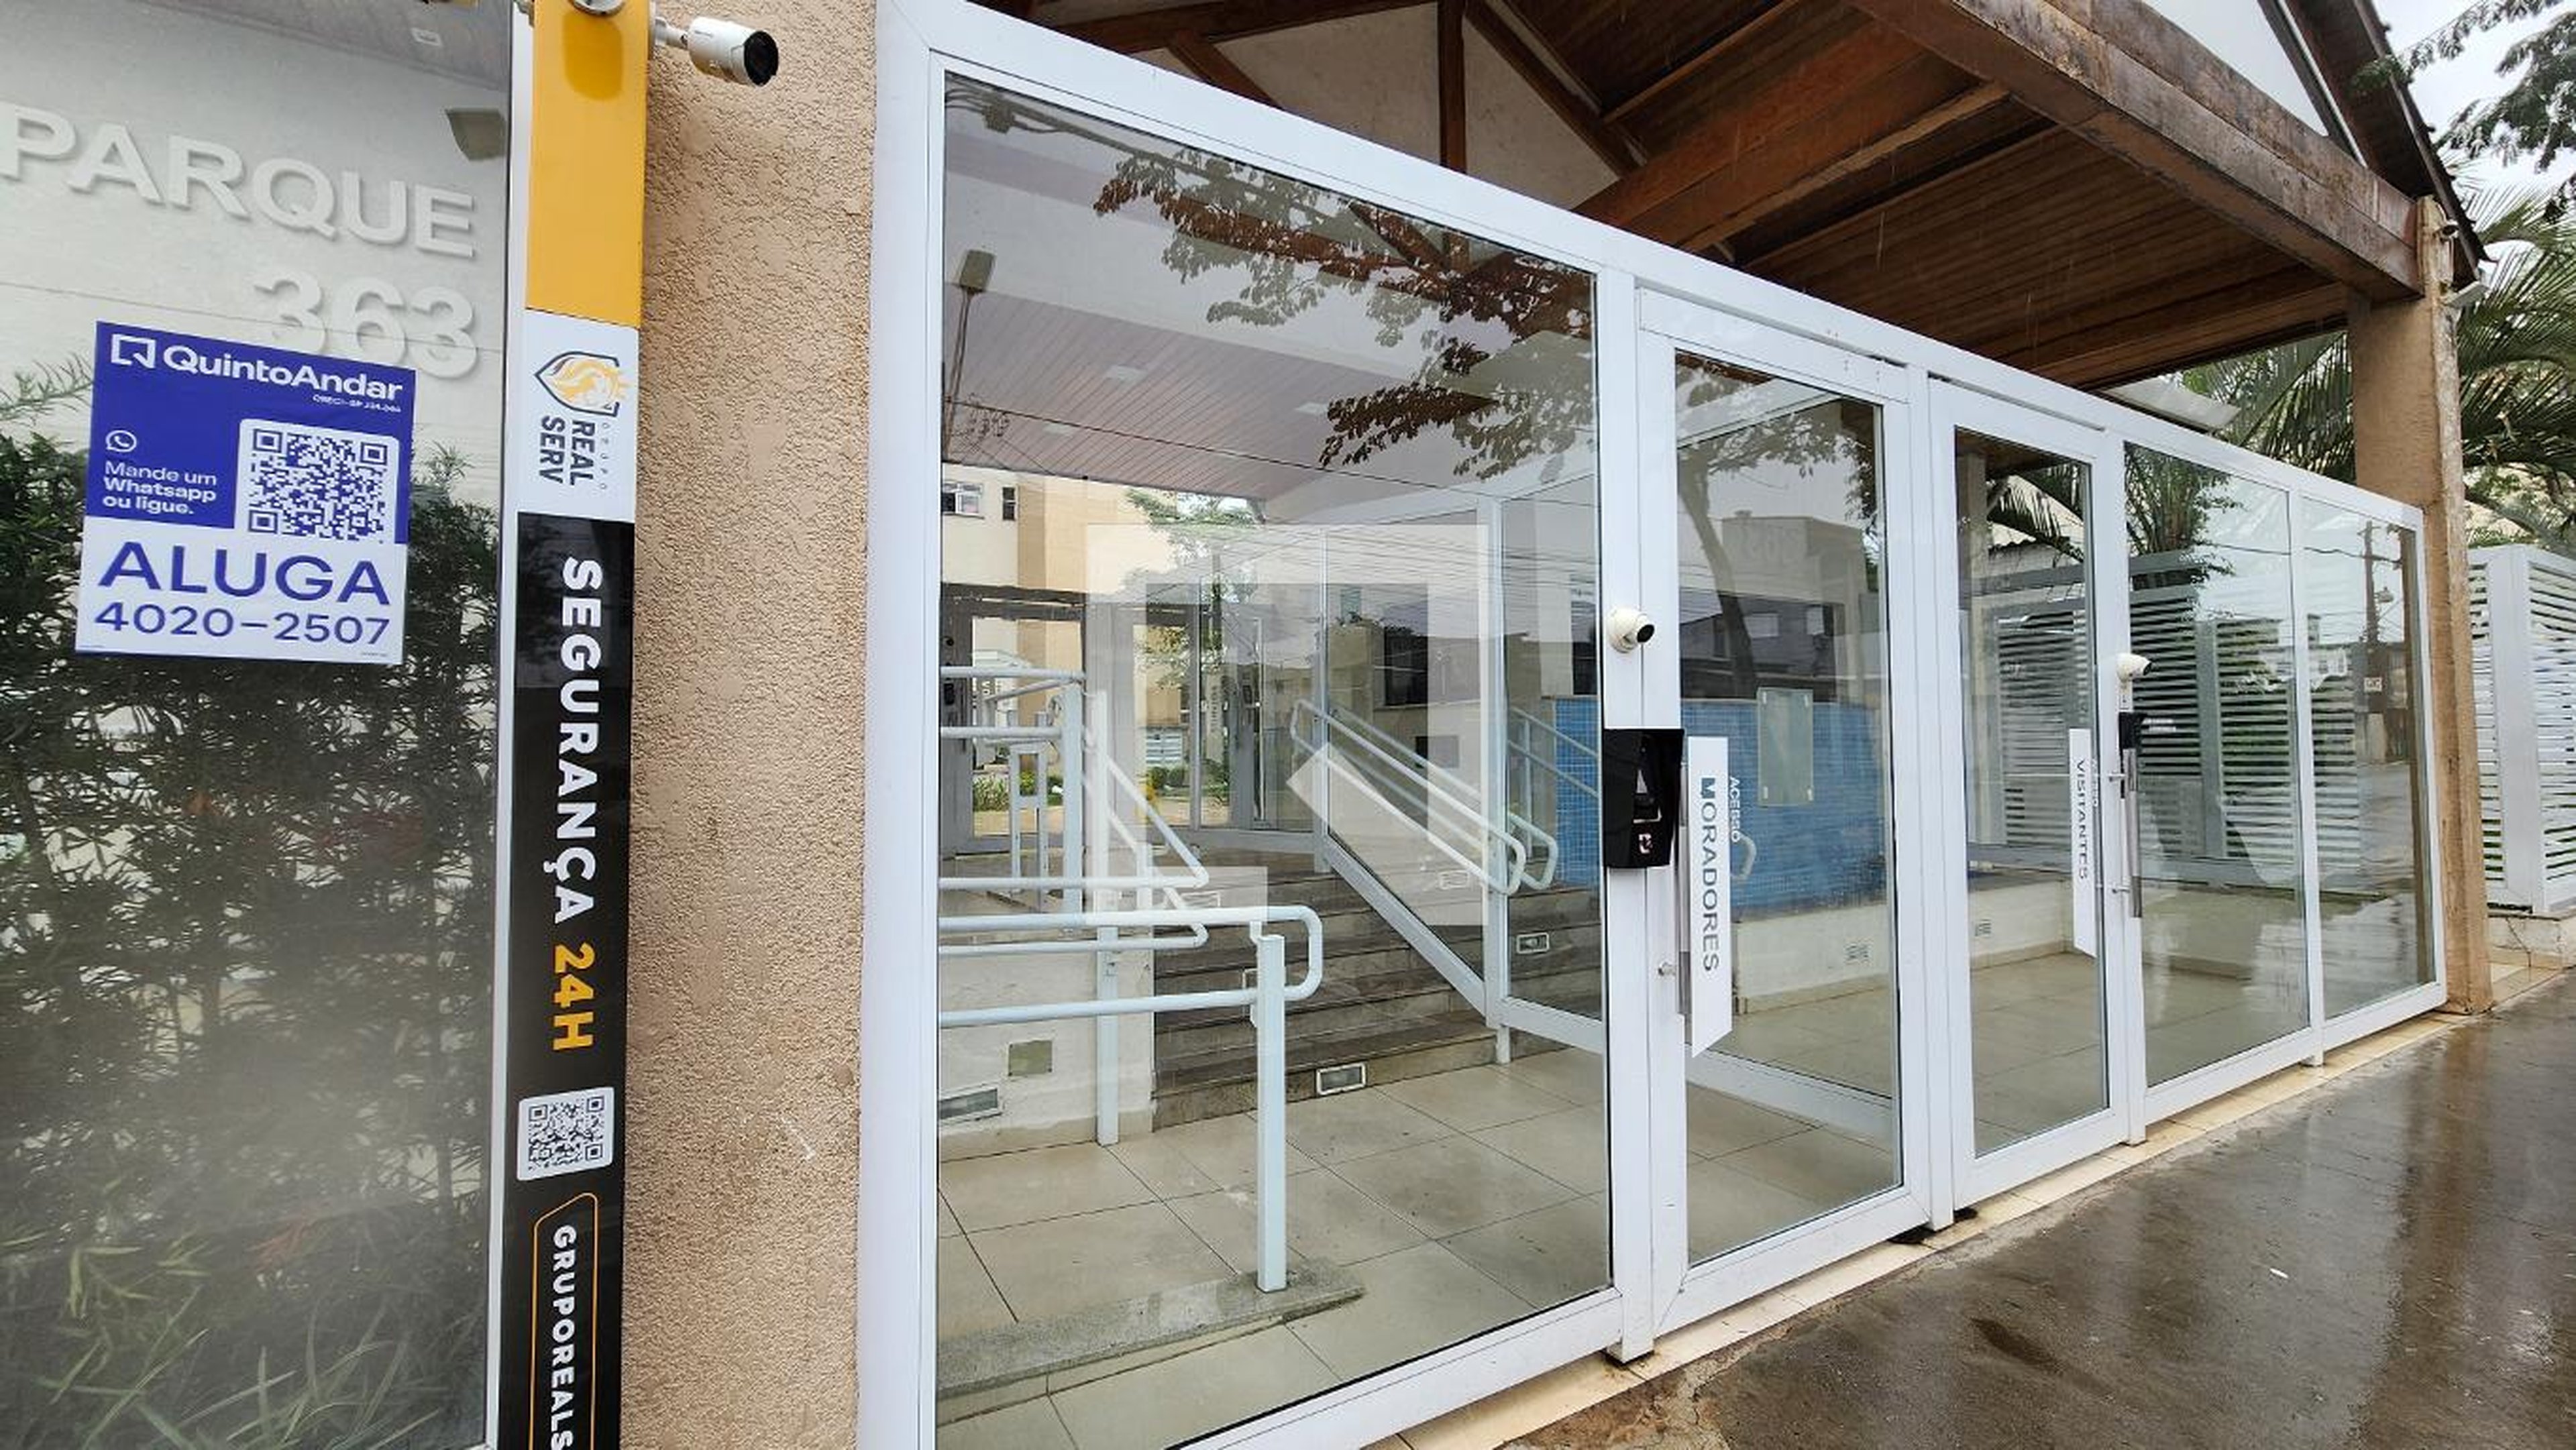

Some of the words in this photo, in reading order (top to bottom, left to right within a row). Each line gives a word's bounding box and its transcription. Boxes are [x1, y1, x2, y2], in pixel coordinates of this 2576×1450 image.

[0, 101, 475, 258] PARQUE
[255, 272, 478, 378] 363
[163, 345, 402, 401] QuintoAndar
[105, 459, 180, 482] Mande
[184, 472, 217, 486] um
[539, 415, 565, 484] SERV
[571, 420, 596, 486] REAL
[103, 476, 217, 503] Whatsapp
[103, 496, 131, 509] ou
[135, 496, 195, 515] ligue.
[98, 541, 391, 606] ALUGA
[94, 601, 390, 645] 4020-2507
[542, 556, 603, 925] SEGURANÇA
[2077, 759, 2088, 880] VISITANTES
[1701, 778, 1719, 972] MORADORES
[552, 940, 597, 1052] 24H
[551, 1225, 576, 1450] GRUPOREALS
